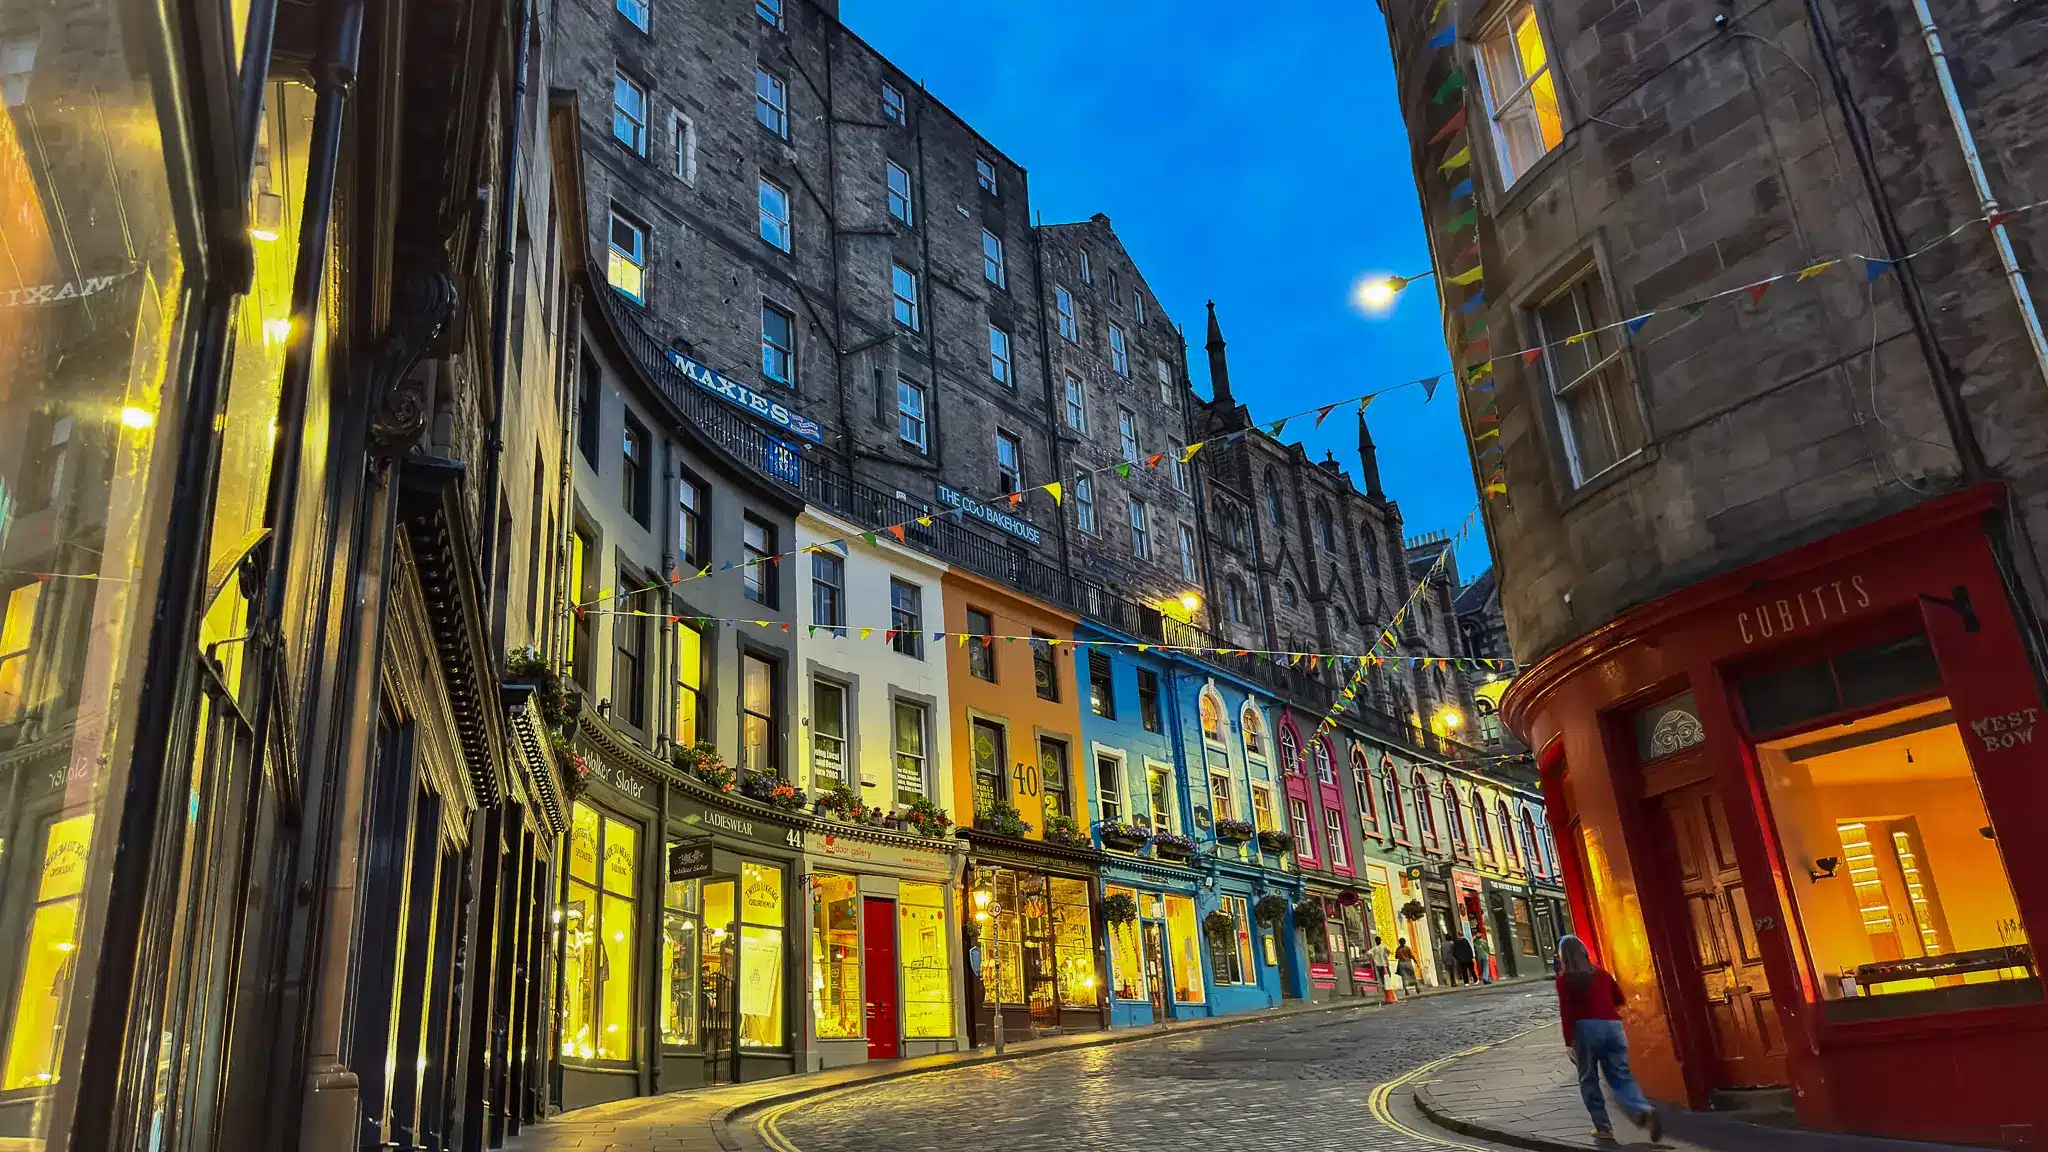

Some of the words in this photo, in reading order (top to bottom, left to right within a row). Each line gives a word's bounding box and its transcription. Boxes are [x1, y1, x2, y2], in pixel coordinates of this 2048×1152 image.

[675, 354, 790, 425] MAXIES
[939, 485, 961, 507] THE
[986, 508, 1040, 544] BAKEHOUSE
[1737, 575, 1871, 645] CUBITTS
[1969, 708, 2038, 737] WEST
[1983, 726, 2032, 752] BOW
[615, 769, 644, 799] Slater
[1013, 762, 1038, 797] 40
[704, 810, 753, 836] LADIESWEAR
[851, 847, 872, 860] gallery
